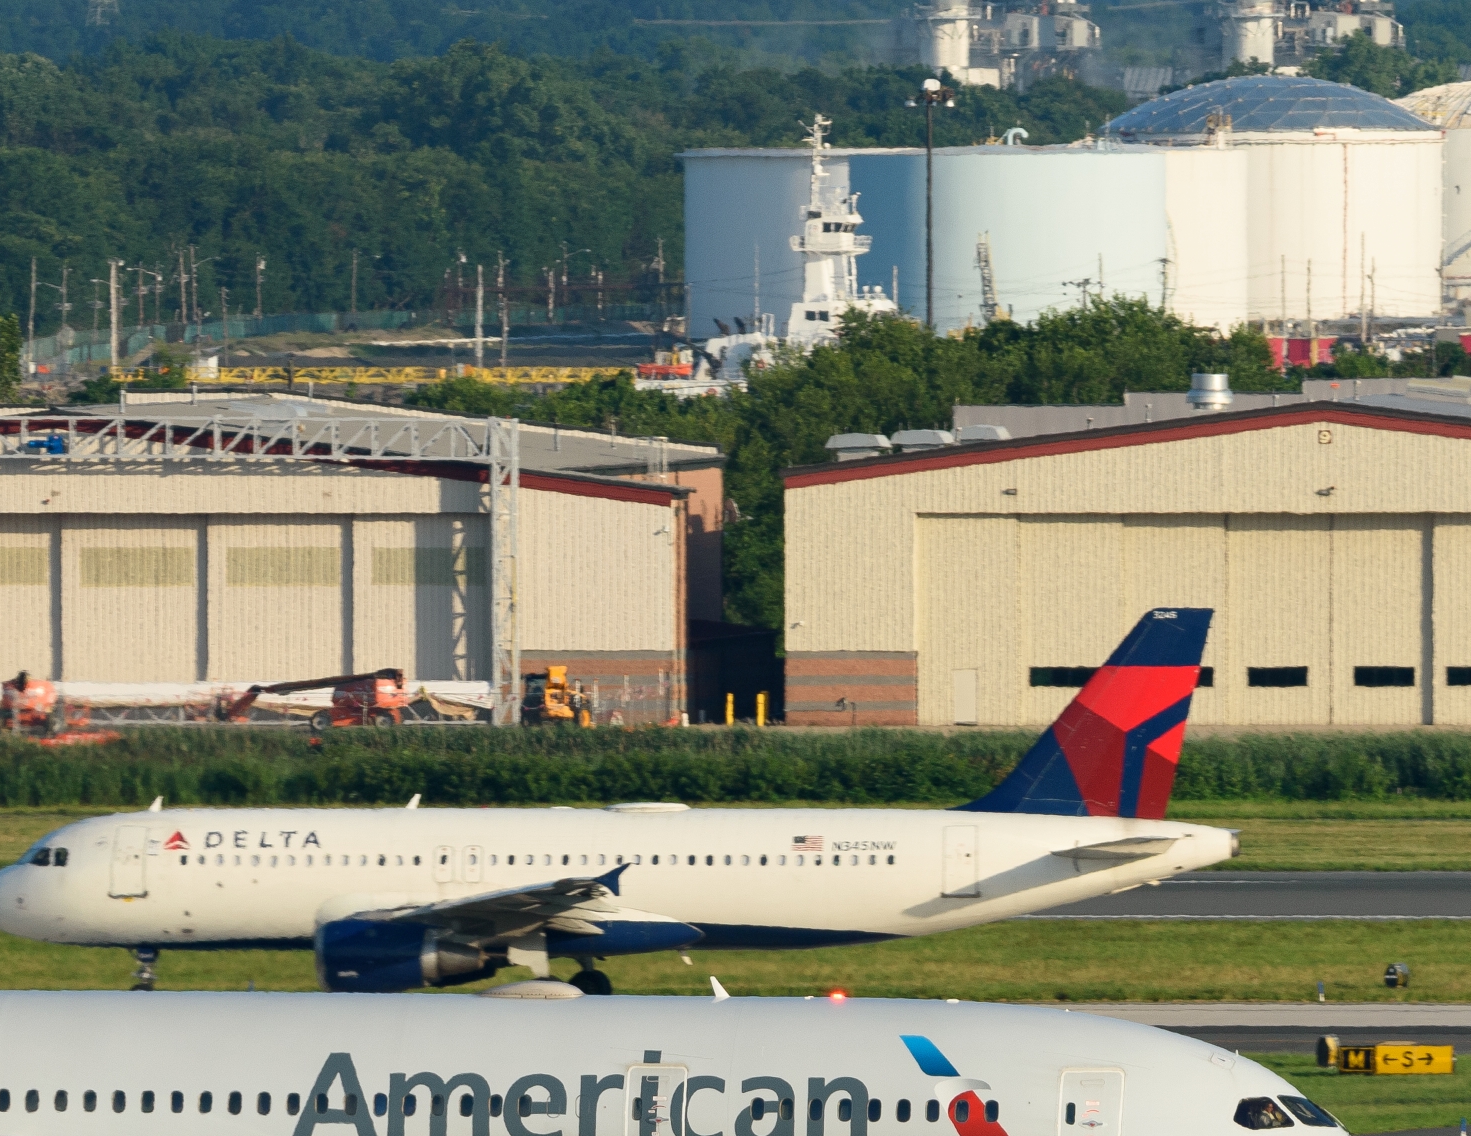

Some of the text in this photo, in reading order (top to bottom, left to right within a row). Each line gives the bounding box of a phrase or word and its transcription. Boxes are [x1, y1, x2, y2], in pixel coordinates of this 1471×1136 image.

[205, 830, 321, 849] DELTA
[831, 840, 897, 852] N345NW
[1348, 1050, 1414, 1068] M S
